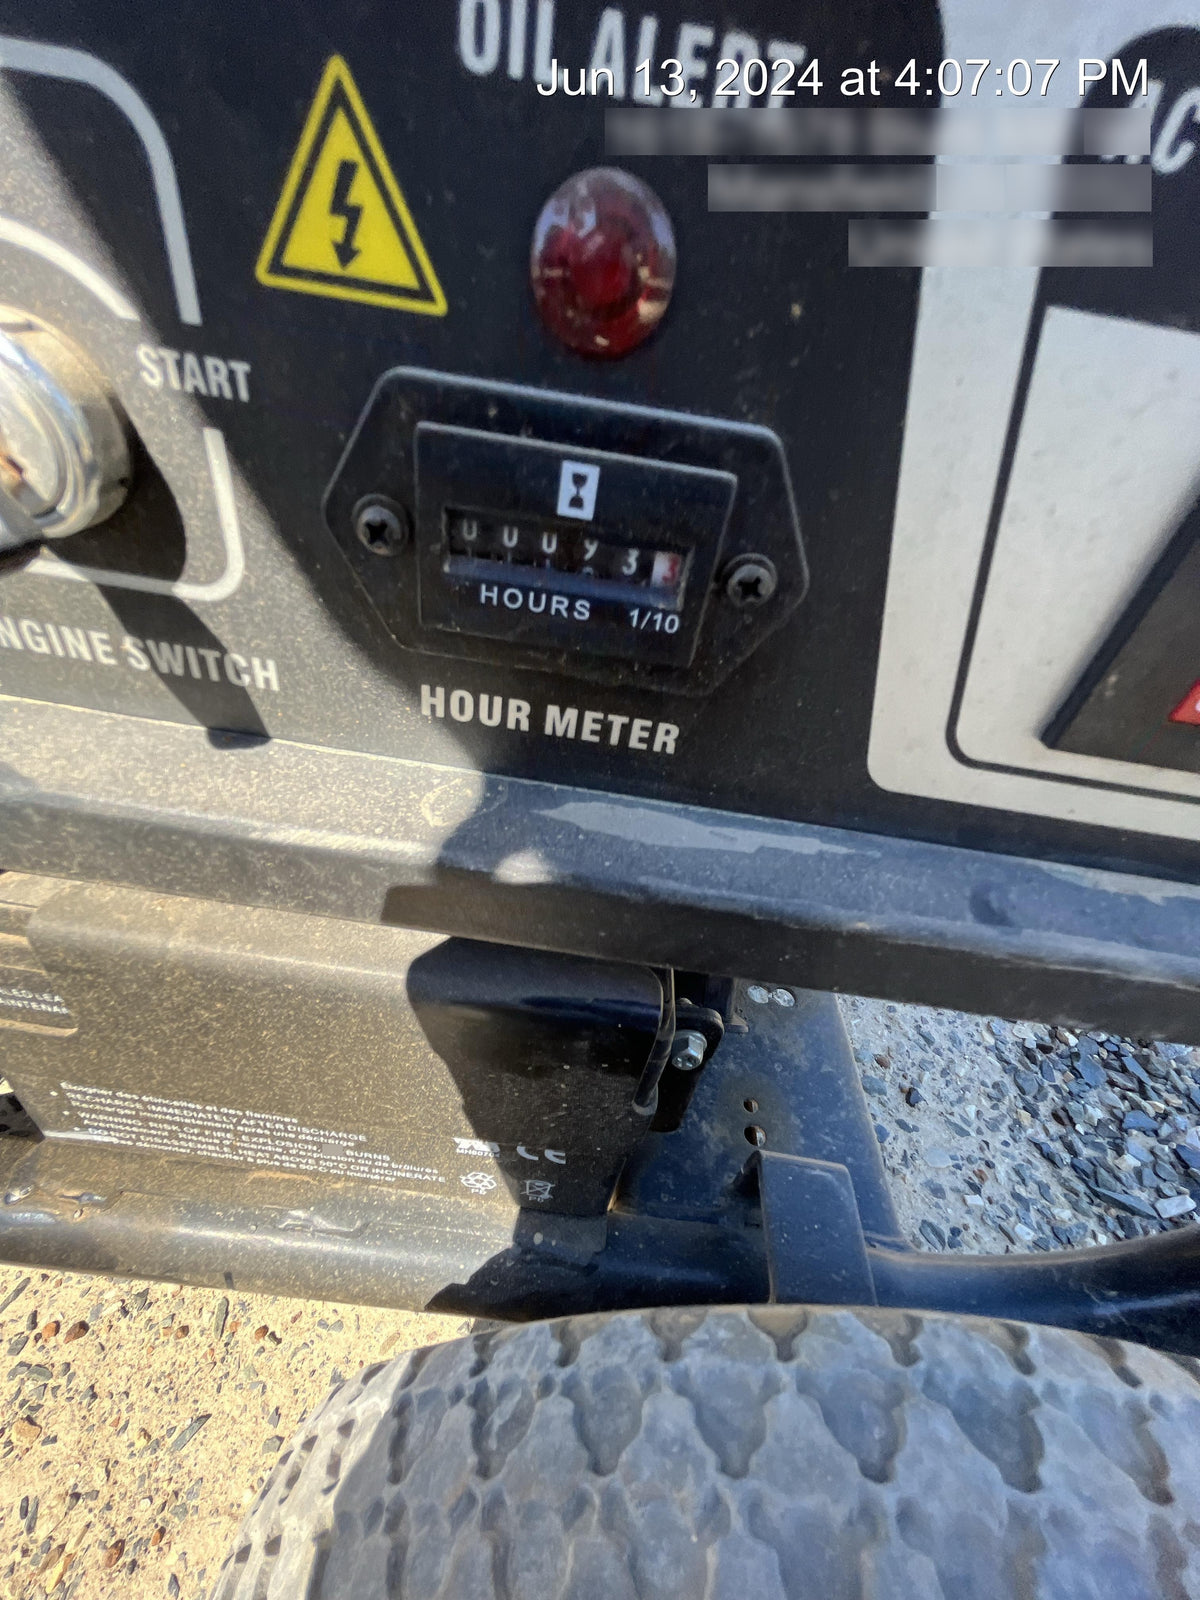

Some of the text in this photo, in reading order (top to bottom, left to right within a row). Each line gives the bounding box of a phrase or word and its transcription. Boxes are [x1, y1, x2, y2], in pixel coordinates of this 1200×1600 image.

[459, 0, 806, 108] OIL ALERT
[137, 344, 251, 403] START
[480, 583, 681, 634] HOURS 1/10
[122, 635, 280, 692] SWITCH
[420, 684, 680, 755] HOUR METER
[66, 1092, 368, 1142] RECHARGE IMMEDIATELY AFTER DISCHARGE
[148, 1121, 181, 1132] RISK
[183, 1126, 200, 1134] OF
[345, 1149, 391, 1162] BURNS
[273, 1131, 296, 1139] une
[88, 1127, 108, 1136] DO
[109, 1130, 136, 1140] NOT
[238, 1148, 270, 1159] HEAT
[273, 1153, 317, 1165] ABOVE
[350, 1164, 369, 1173] OR
[371, 1167, 446, 1184] INCINERATE
[282, 1161, 297, 1169] de
[357, 1158, 372, 1166] ou
[374, 1160, 389, 1168] de
